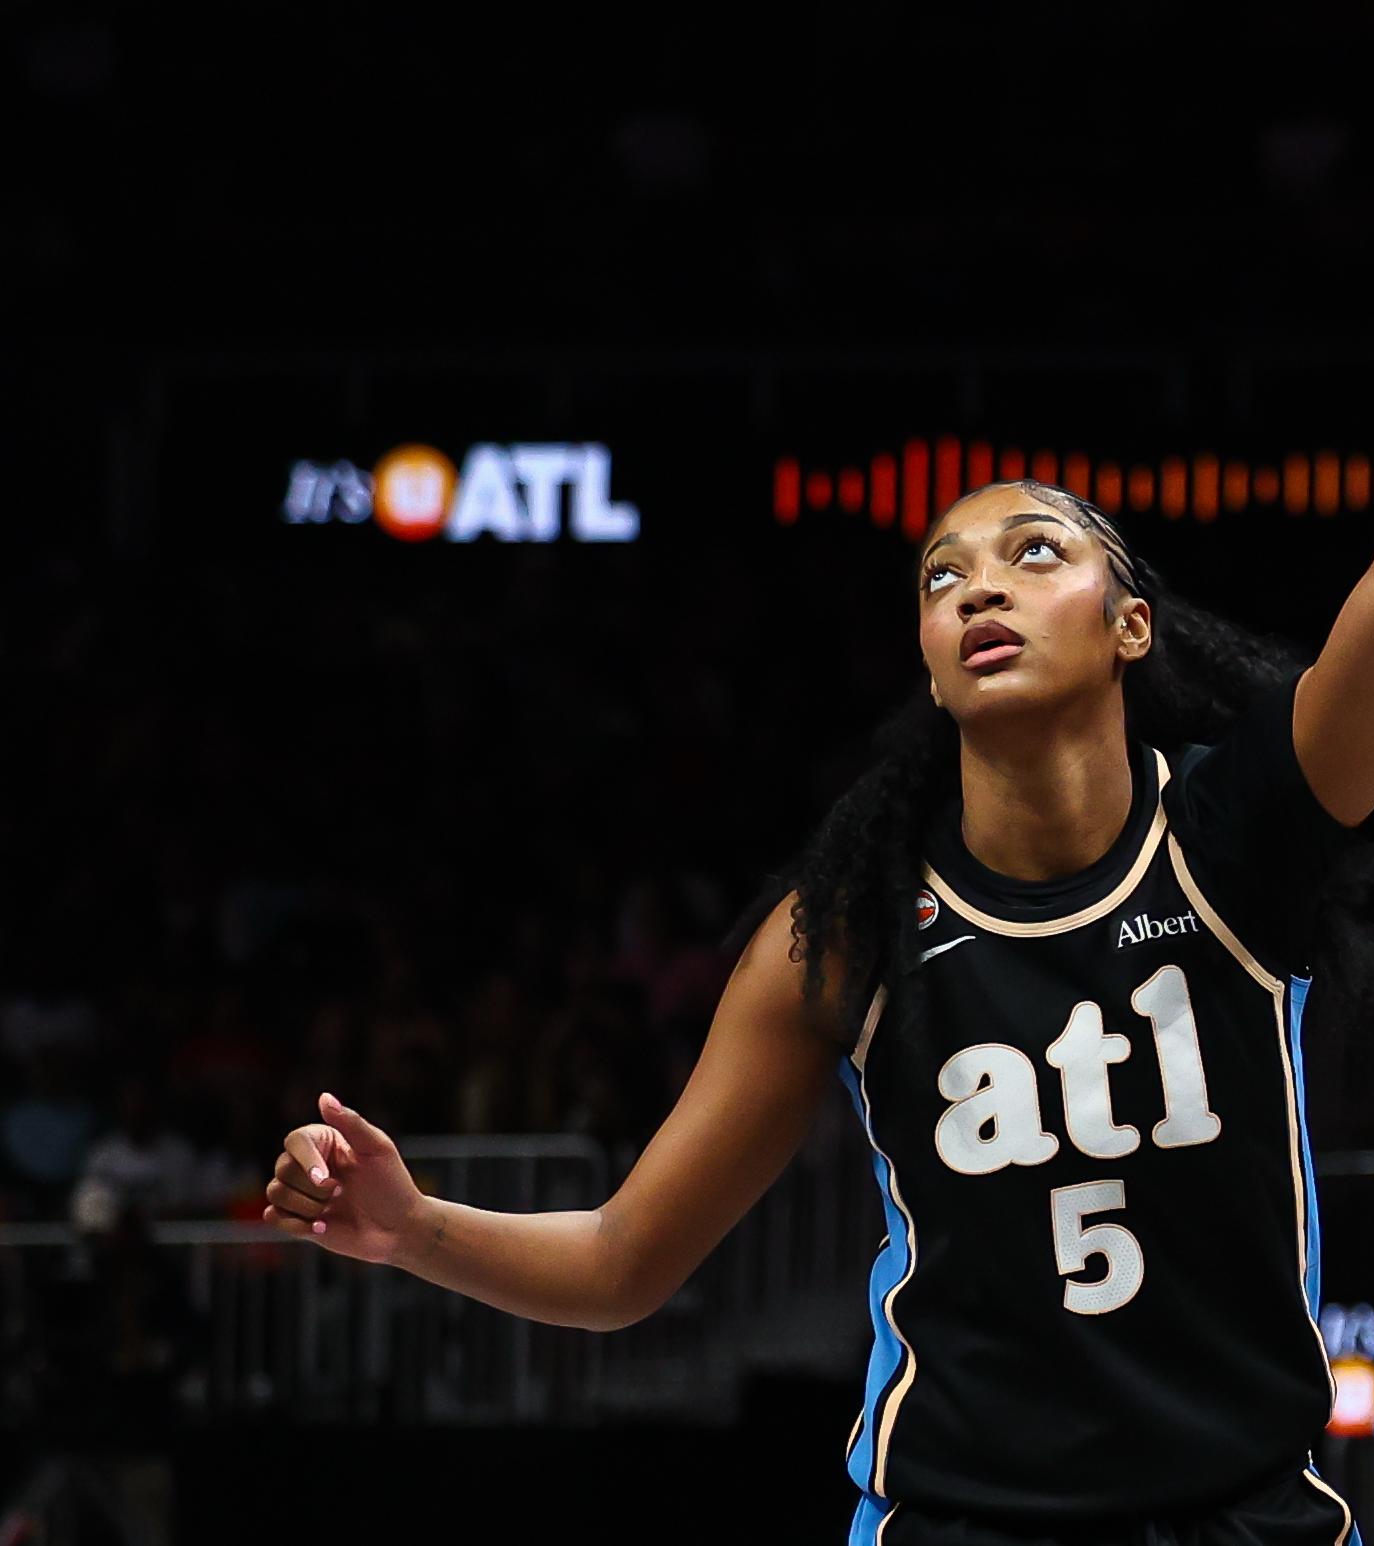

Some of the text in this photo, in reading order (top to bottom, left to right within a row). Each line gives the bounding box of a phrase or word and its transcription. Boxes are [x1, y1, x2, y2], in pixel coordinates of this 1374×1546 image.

[447, 441, 640, 542] ATL
[1117, 910, 1200, 948] Albert
[934, 964, 1222, 1176] atl
[1050, 1179, 1144, 1316] 5
